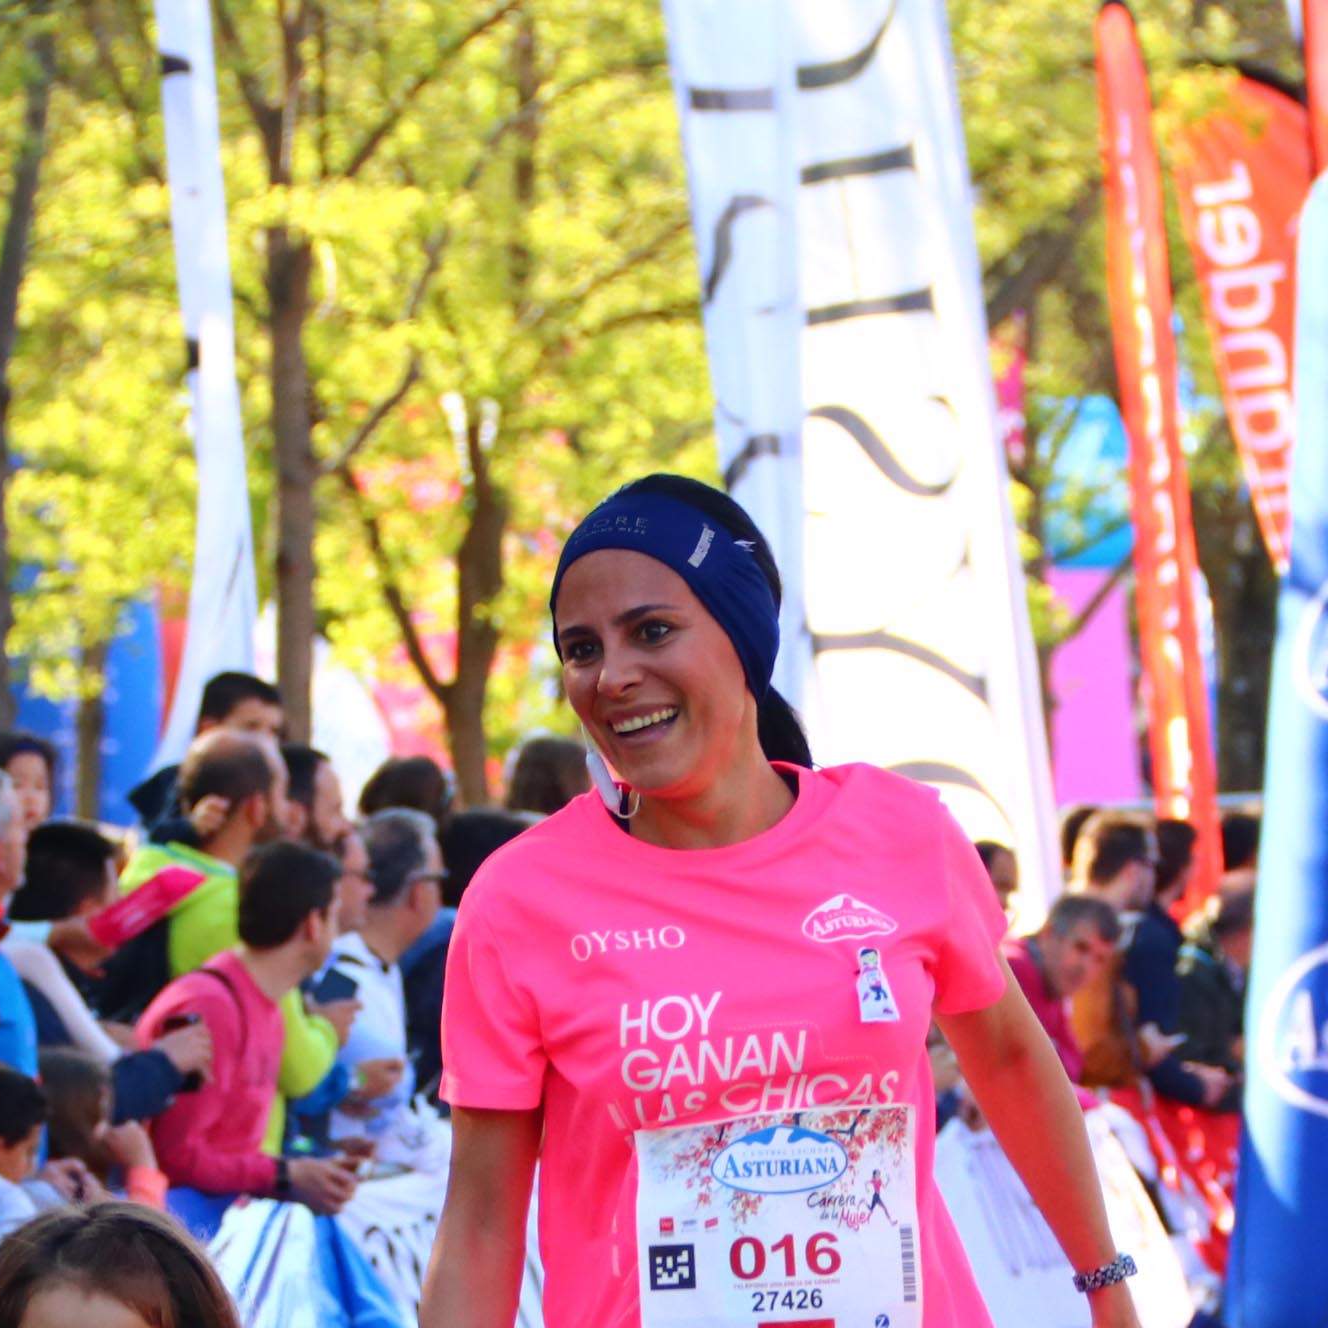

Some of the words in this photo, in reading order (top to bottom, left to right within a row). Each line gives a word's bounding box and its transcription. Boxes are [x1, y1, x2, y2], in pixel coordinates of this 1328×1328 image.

[570, 926, 686, 961] OYSHO
[619, 991, 723, 1047] HOY
[621, 1029, 808, 1093] GANAN
[719, 1069, 900, 1115] CHICAS
[723, 1153, 839, 1178] ASTURIANA
[729, 1231, 842, 1281] 016
[751, 1287, 824, 1313] 27426
